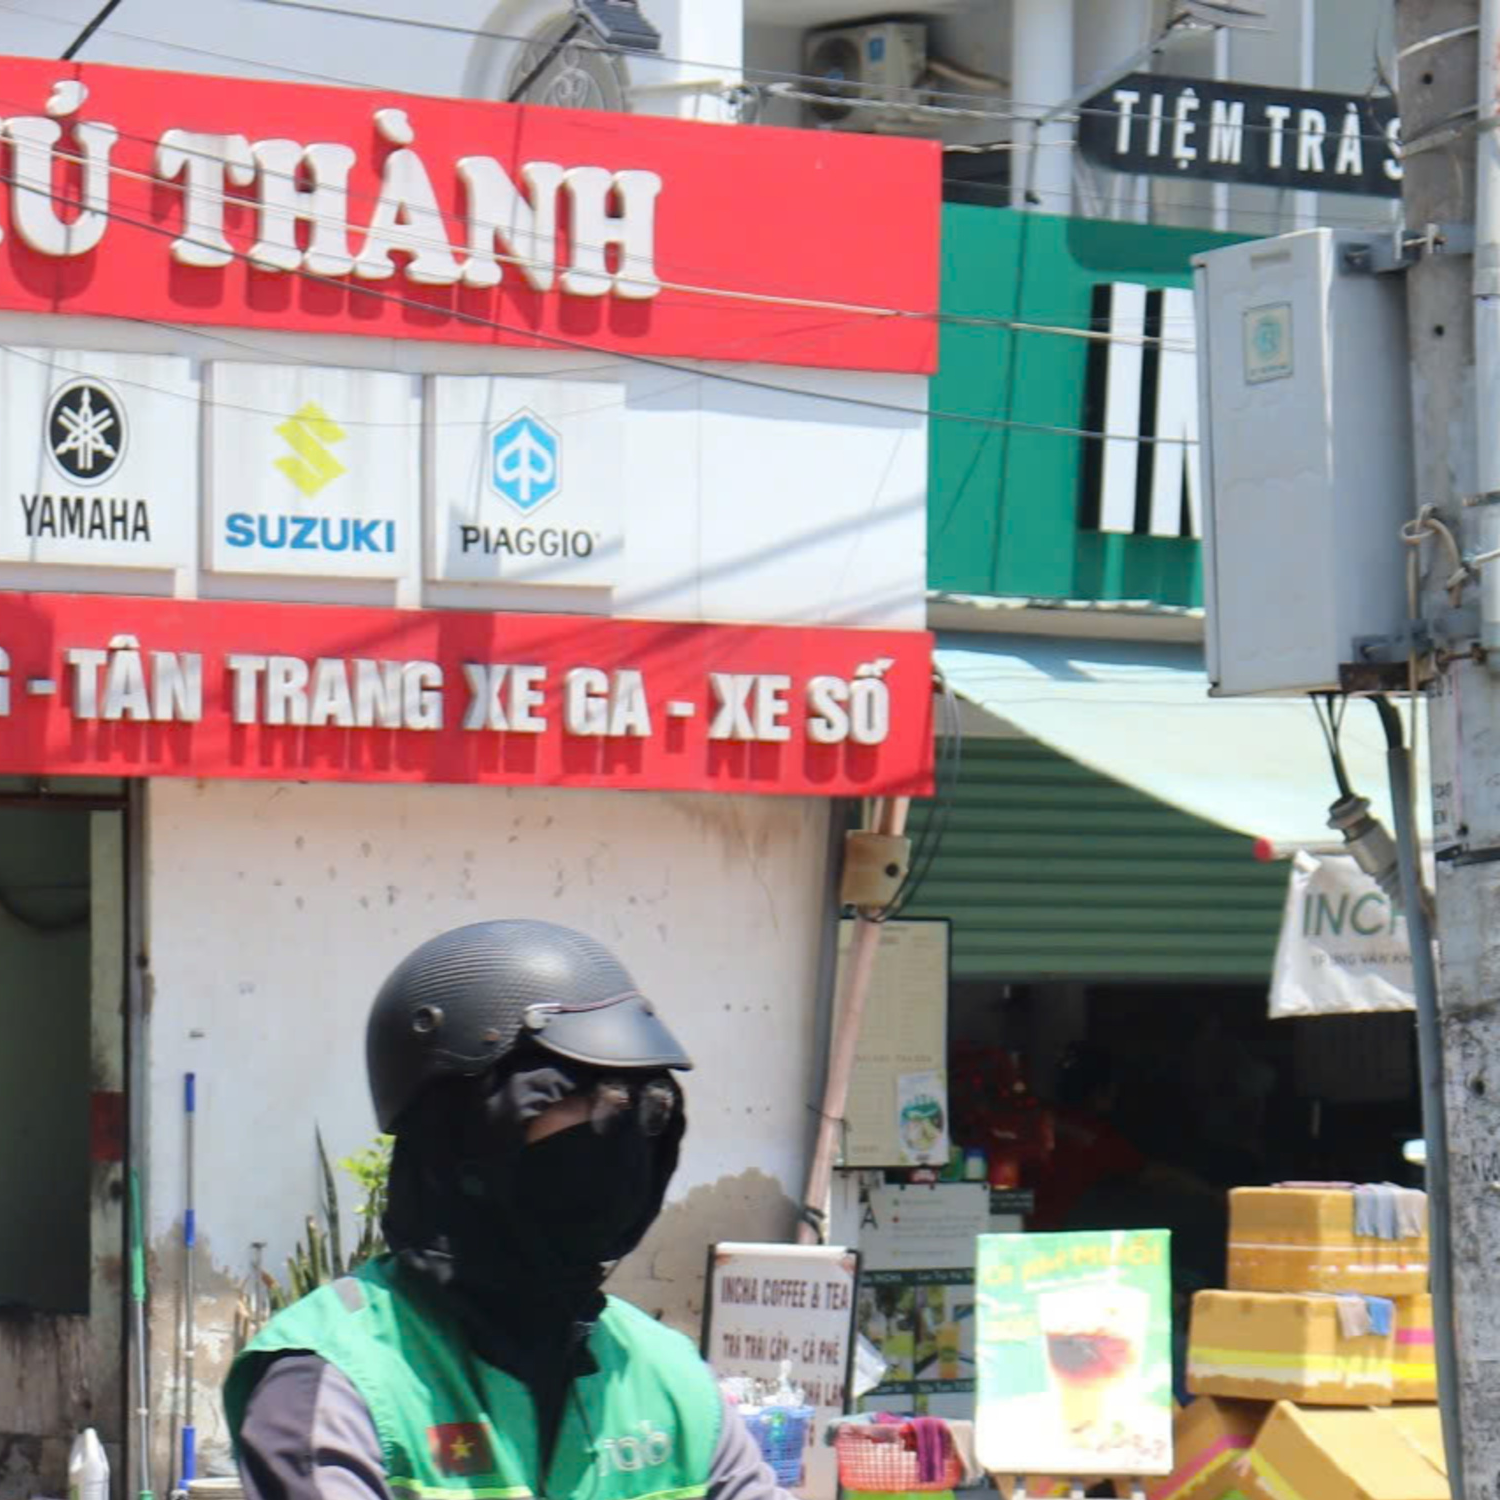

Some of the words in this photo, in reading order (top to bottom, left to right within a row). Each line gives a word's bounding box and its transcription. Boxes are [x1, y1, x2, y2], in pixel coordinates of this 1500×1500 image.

[1112, 87, 1243, 171] TIỆM
[1263, 102, 1364, 177] TRÀ
[157, 108, 664, 299] THÀNH
[19, 493, 152, 543] YAMAHA
[224, 511, 396, 555] SUZUKI
[460, 523, 594, 559] PIAGGIO
[65, 633, 202, 723] TÂN
[224, 653, 444, 732] TRANG
[462, 662, 548, 734] XE
[561, 667, 652, 737] GA
[707, 672, 792, 744] XE
[805, 656, 896, 746] SỐ
[761, 1278, 808, 1308] COFFEE
[825, 1281, 850, 1311] TEA
[598, 1418, 674, 1478] rab
